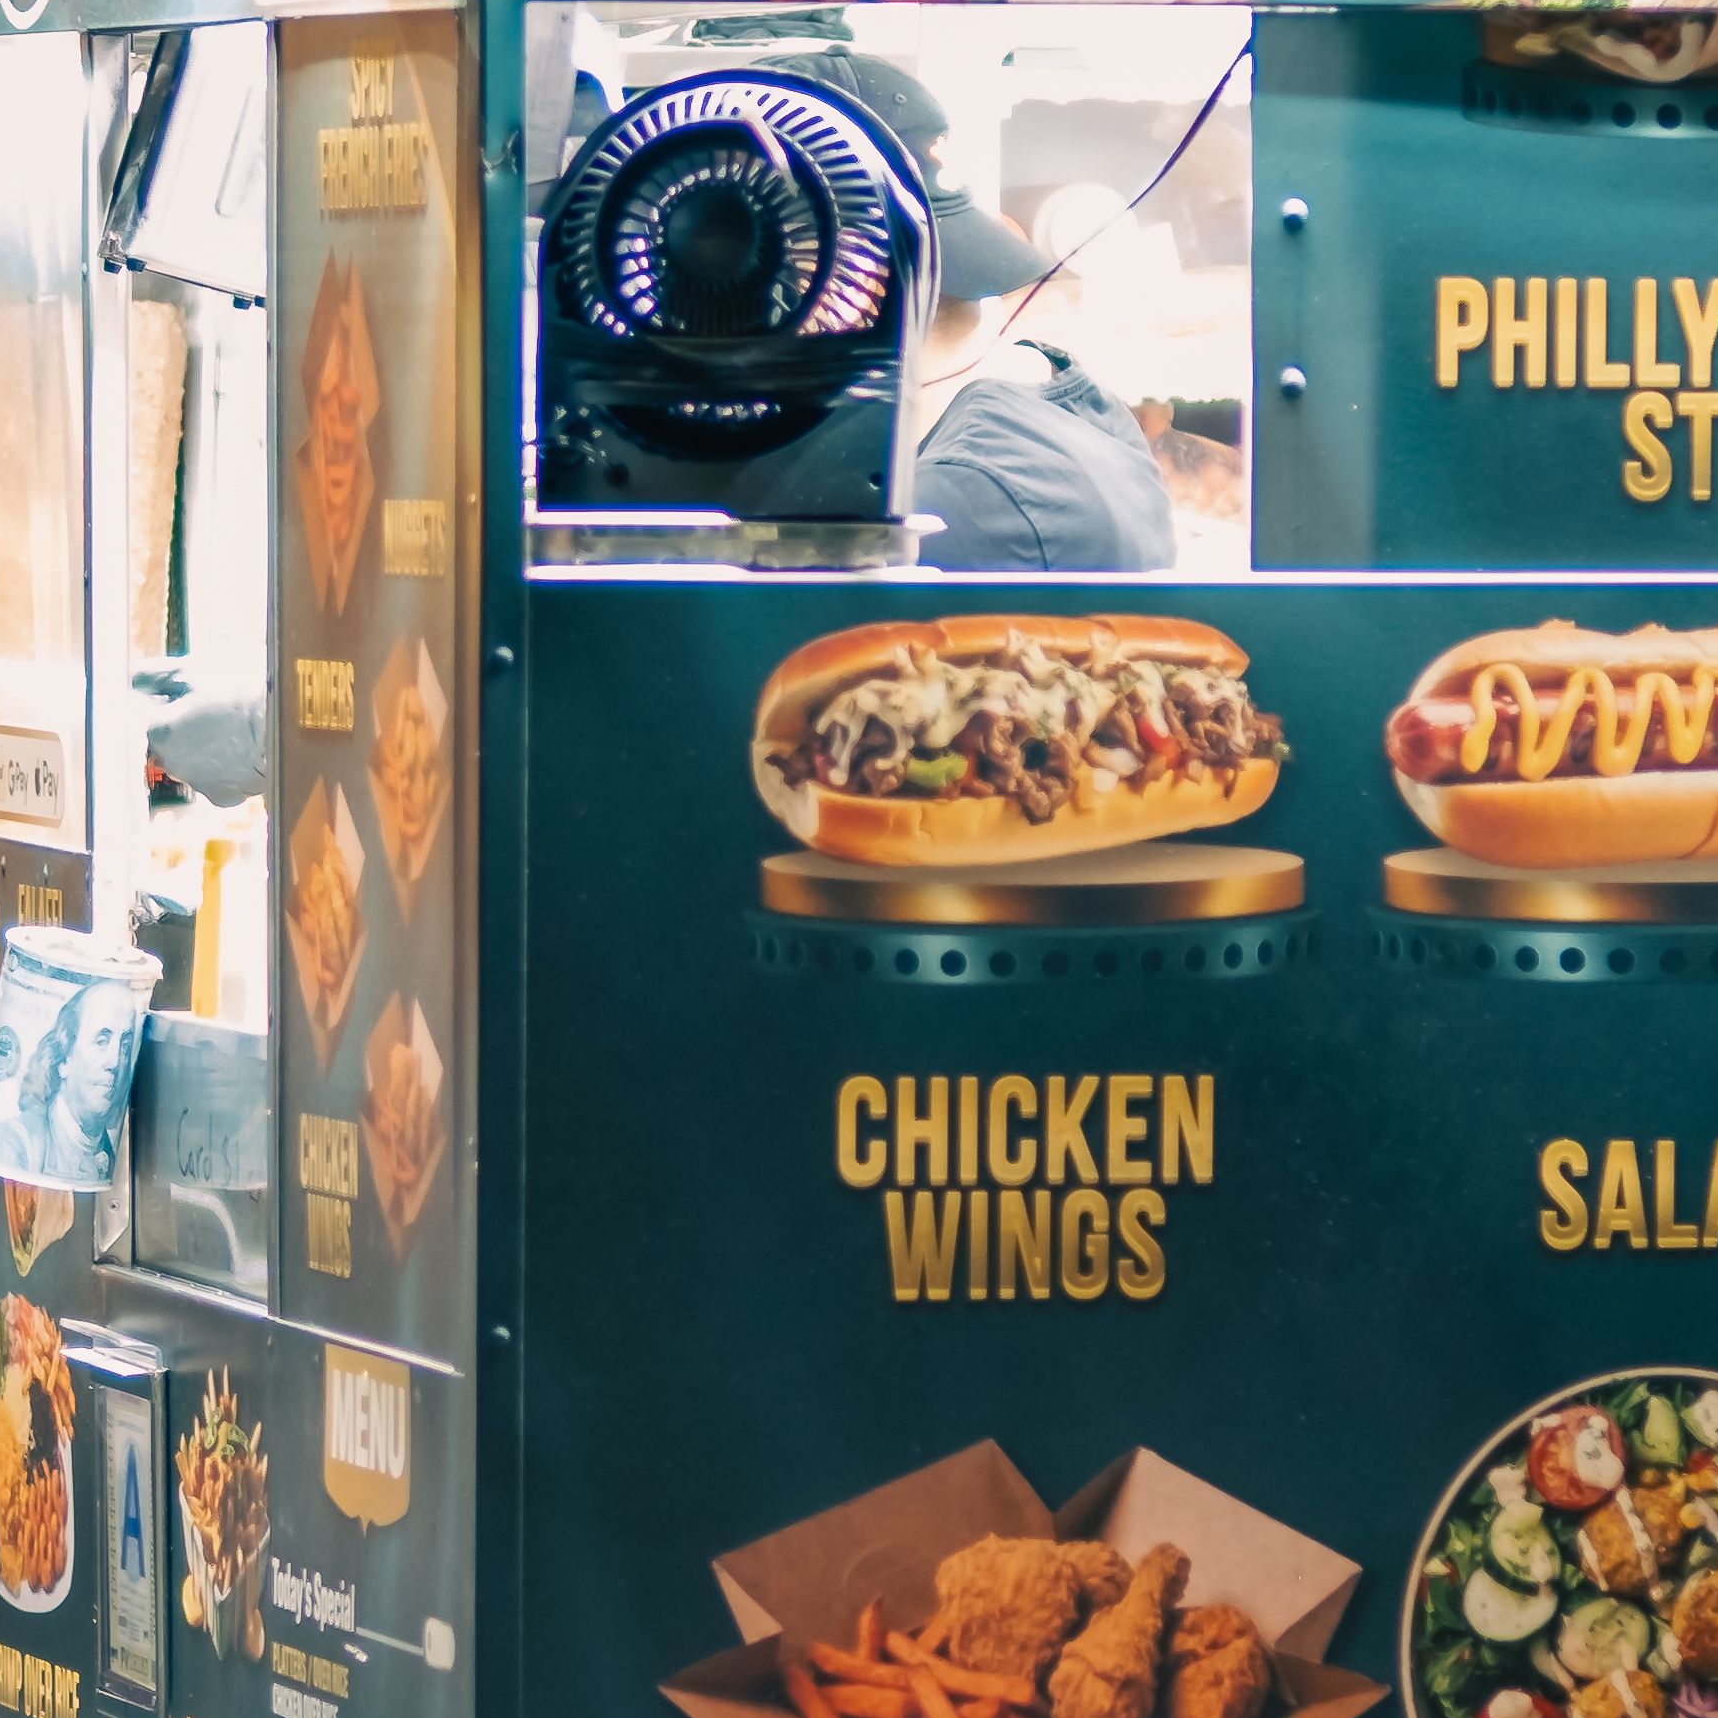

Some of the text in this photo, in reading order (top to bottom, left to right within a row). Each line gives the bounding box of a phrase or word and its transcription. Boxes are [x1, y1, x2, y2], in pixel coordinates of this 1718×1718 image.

[299, 1113, 358, 1195] CHICKEN
[836, 1074, 1215, 1187] CHICKEN
[885, 1189, 1167, 1302] WINGS
[330, 1368, 405, 1479] MENU
[271, 1556, 355, 1632] Today's Special
